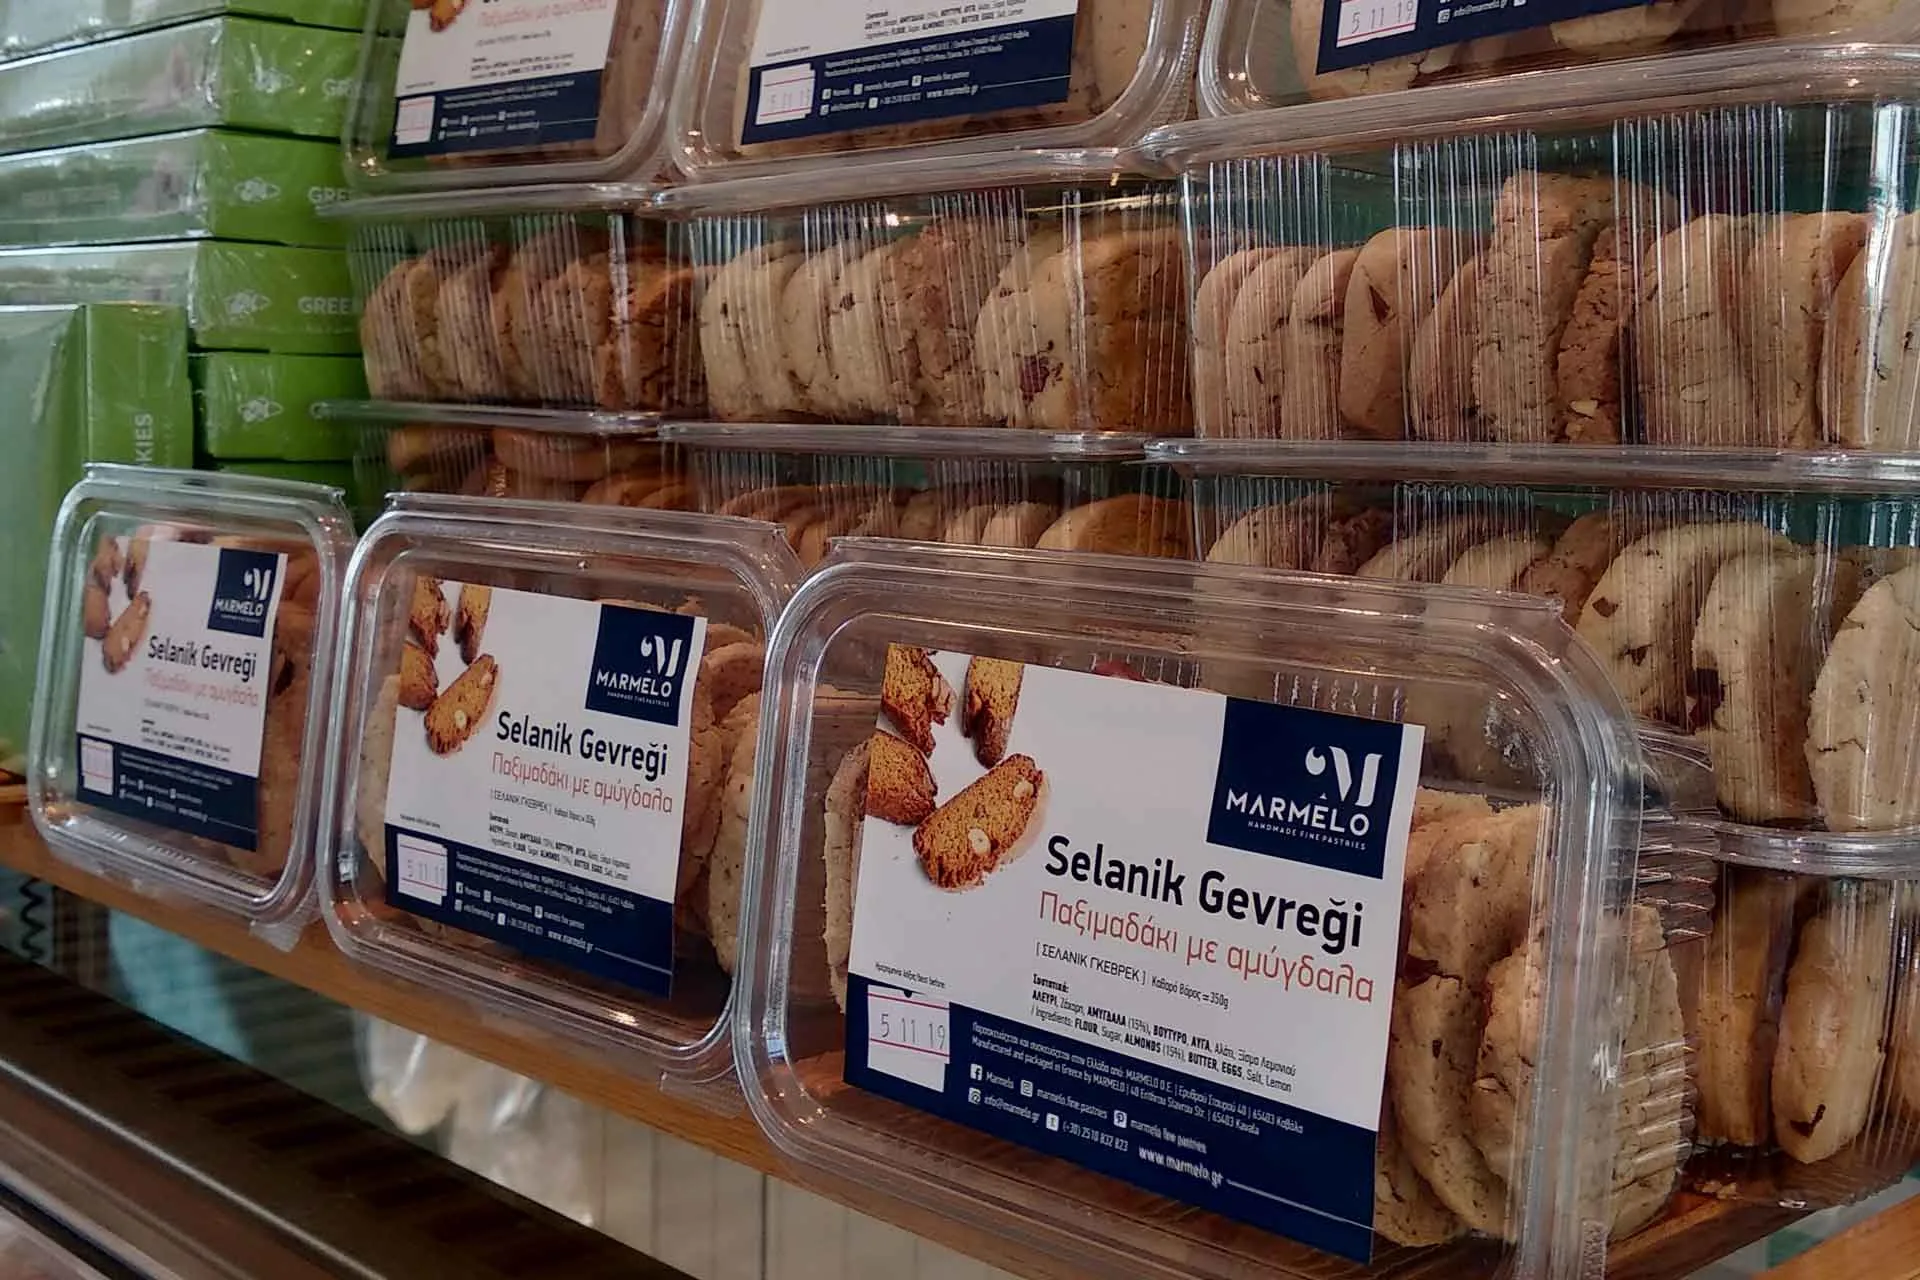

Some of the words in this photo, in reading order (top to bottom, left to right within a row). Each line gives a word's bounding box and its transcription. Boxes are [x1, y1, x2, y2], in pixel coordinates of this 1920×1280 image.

[1351, 12, 1361, 34] 5
[1370, 7, 1385, 30] 11
[308, 186, 350, 203] GRE
[298, 296, 355, 315] GREE
[134, 413, 154, 463] KIES
[147, 635, 199, 667] Selanik
[201, 644, 257, 682] Gevreği
[496, 711, 573, 755] Selanik
[579, 728, 668, 782] Gevreği
[492, 751, 570, 789] Παξιμαδάκι
[572, 775, 590, 798] με
[594, 778, 673, 814] αμύγδαλα
[1248, 820, 1297, 837] HANDMADE
[1299, 829, 1321, 842] FINE
[1322, 835, 1367, 851] PASTRIES
[1044, 835, 1186, 907] Selanik
[1199, 870, 1364, 955] Gevreği
[1039, 890, 1178, 953] Παξιμαδάκι
[1186, 935, 1219, 967] με
[1227, 945, 1374, 1003] αμύγδαλα
[1042, 943, 1088, 969] ΣΕΛΑΝΙΚ
[1089, 956, 1141, 983] ΓΚΕΒΡΕΚ
[881, 1013, 890, 1038] 5
[901, 1017, 916, 1044] 11
[928, 1022, 946, 1050] 19
[1083, 1070, 1092, 1085] by
[1093, 1074, 1126, 1093] MARMELO
[1124, 1033, 1162, 1054] ALMONDS
[1188, 1052, 1220, 1073] BUTTER,
[1221, 1062, 1246, 1080] EGGS,
[1266, 1074, 1292, 1093] Lemon
[1138, 1147, 1225, 1189] www.marmelo.gr
